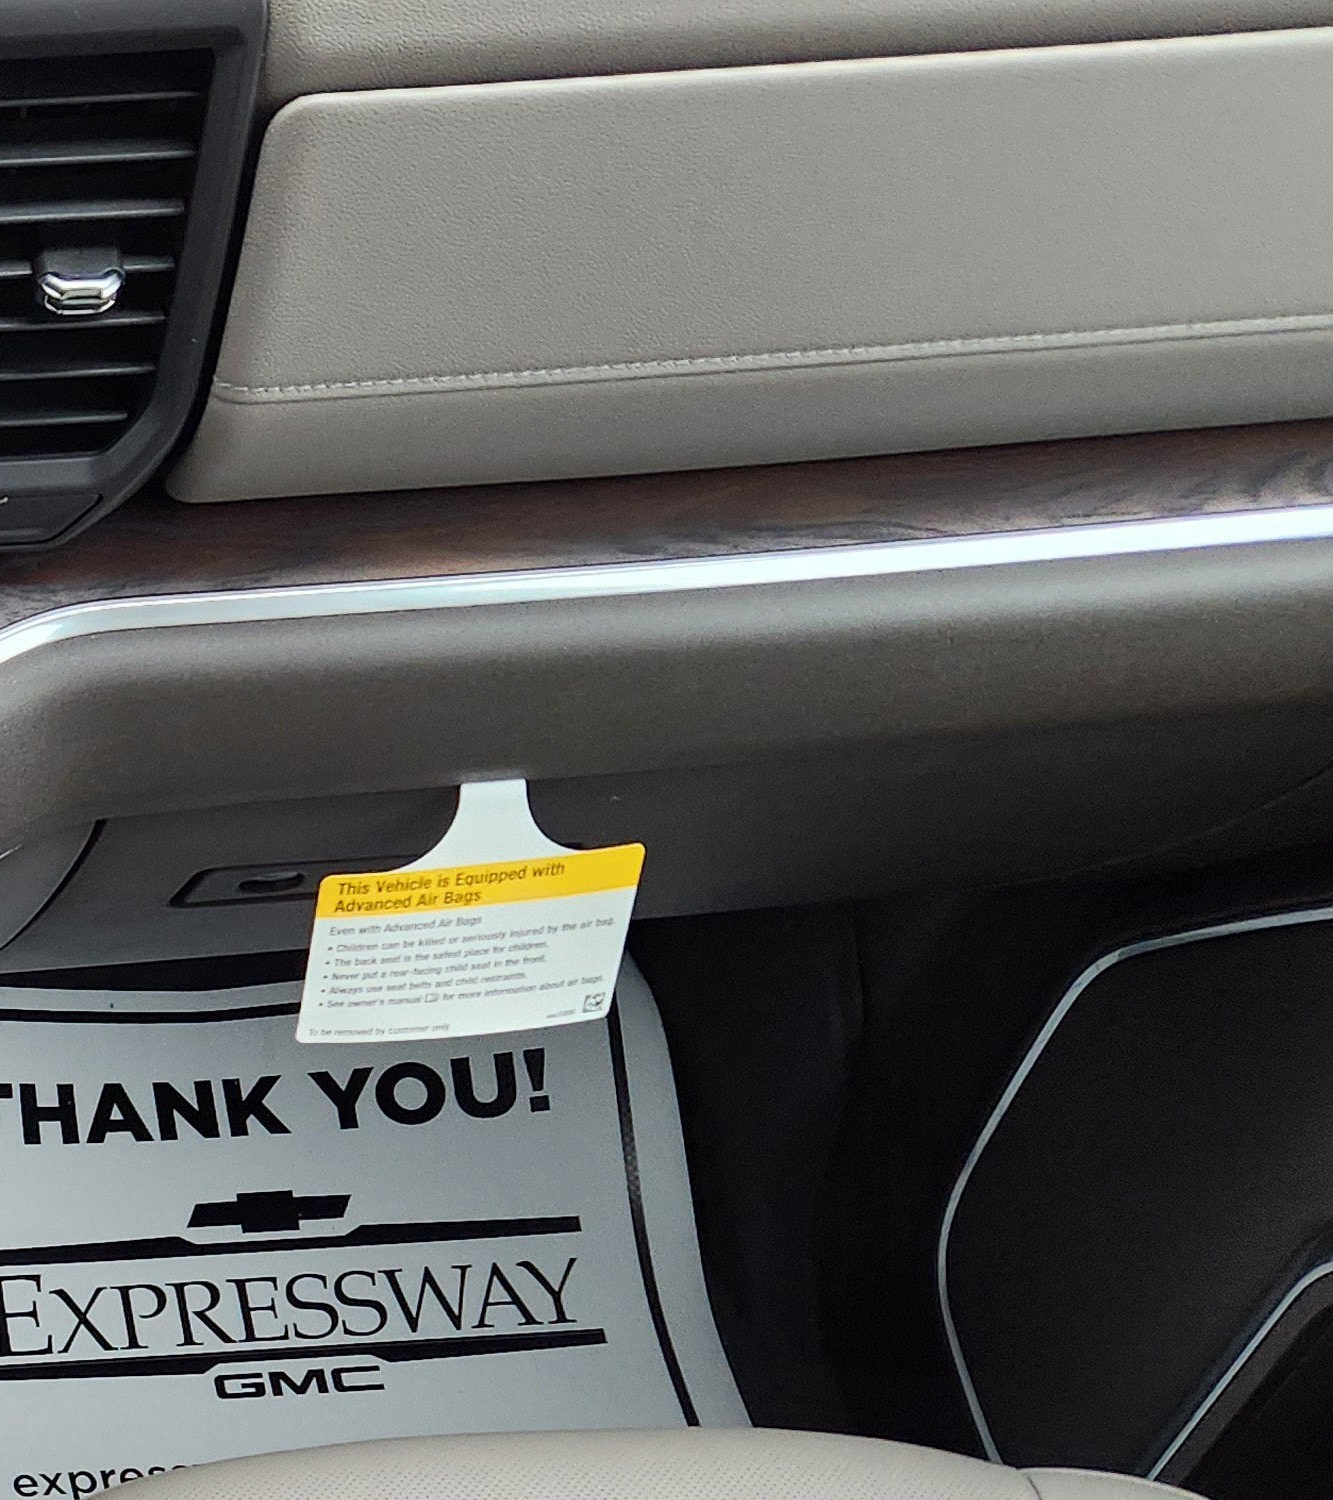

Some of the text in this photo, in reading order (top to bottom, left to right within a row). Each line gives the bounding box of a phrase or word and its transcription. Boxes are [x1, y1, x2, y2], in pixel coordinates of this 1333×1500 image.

[338, 862, 565, 896] This Vehicle is Equipped with
[335, 890, 482, 912] Advanced Air Bags
[383, 919, 437, 932] Advanced
[307, 1048, 552, 1131] YOU!
[213, 1364, 386, 1399] GMC
